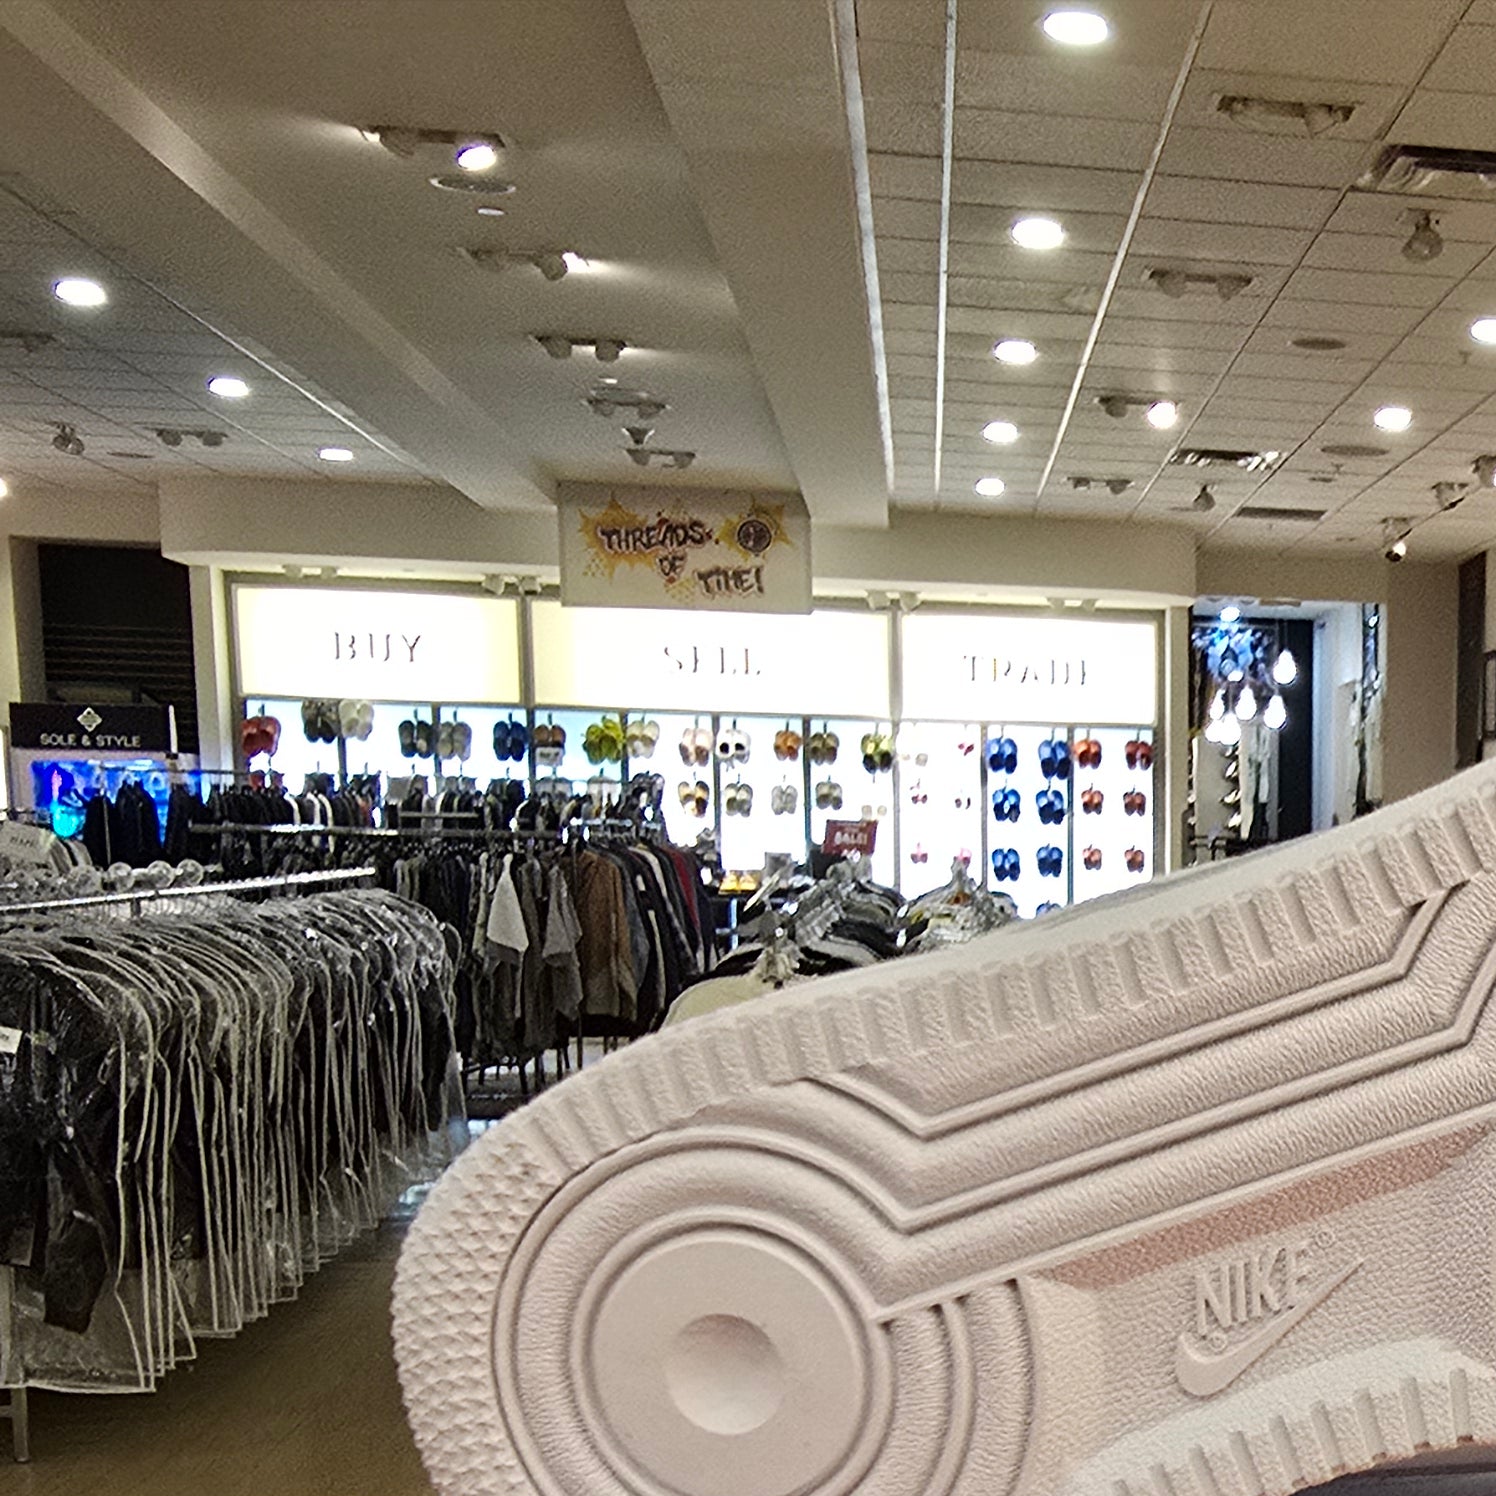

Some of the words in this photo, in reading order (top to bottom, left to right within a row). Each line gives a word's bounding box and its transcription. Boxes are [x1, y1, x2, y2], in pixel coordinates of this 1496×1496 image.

[658, 554, 686, 577] OF
[39, 732, 77, 747] SOLE
[81, 733, 91, 747] &
[95, 734, 142, 749] STYLE
[1196, 1244, 1312, 1340] NIKE
